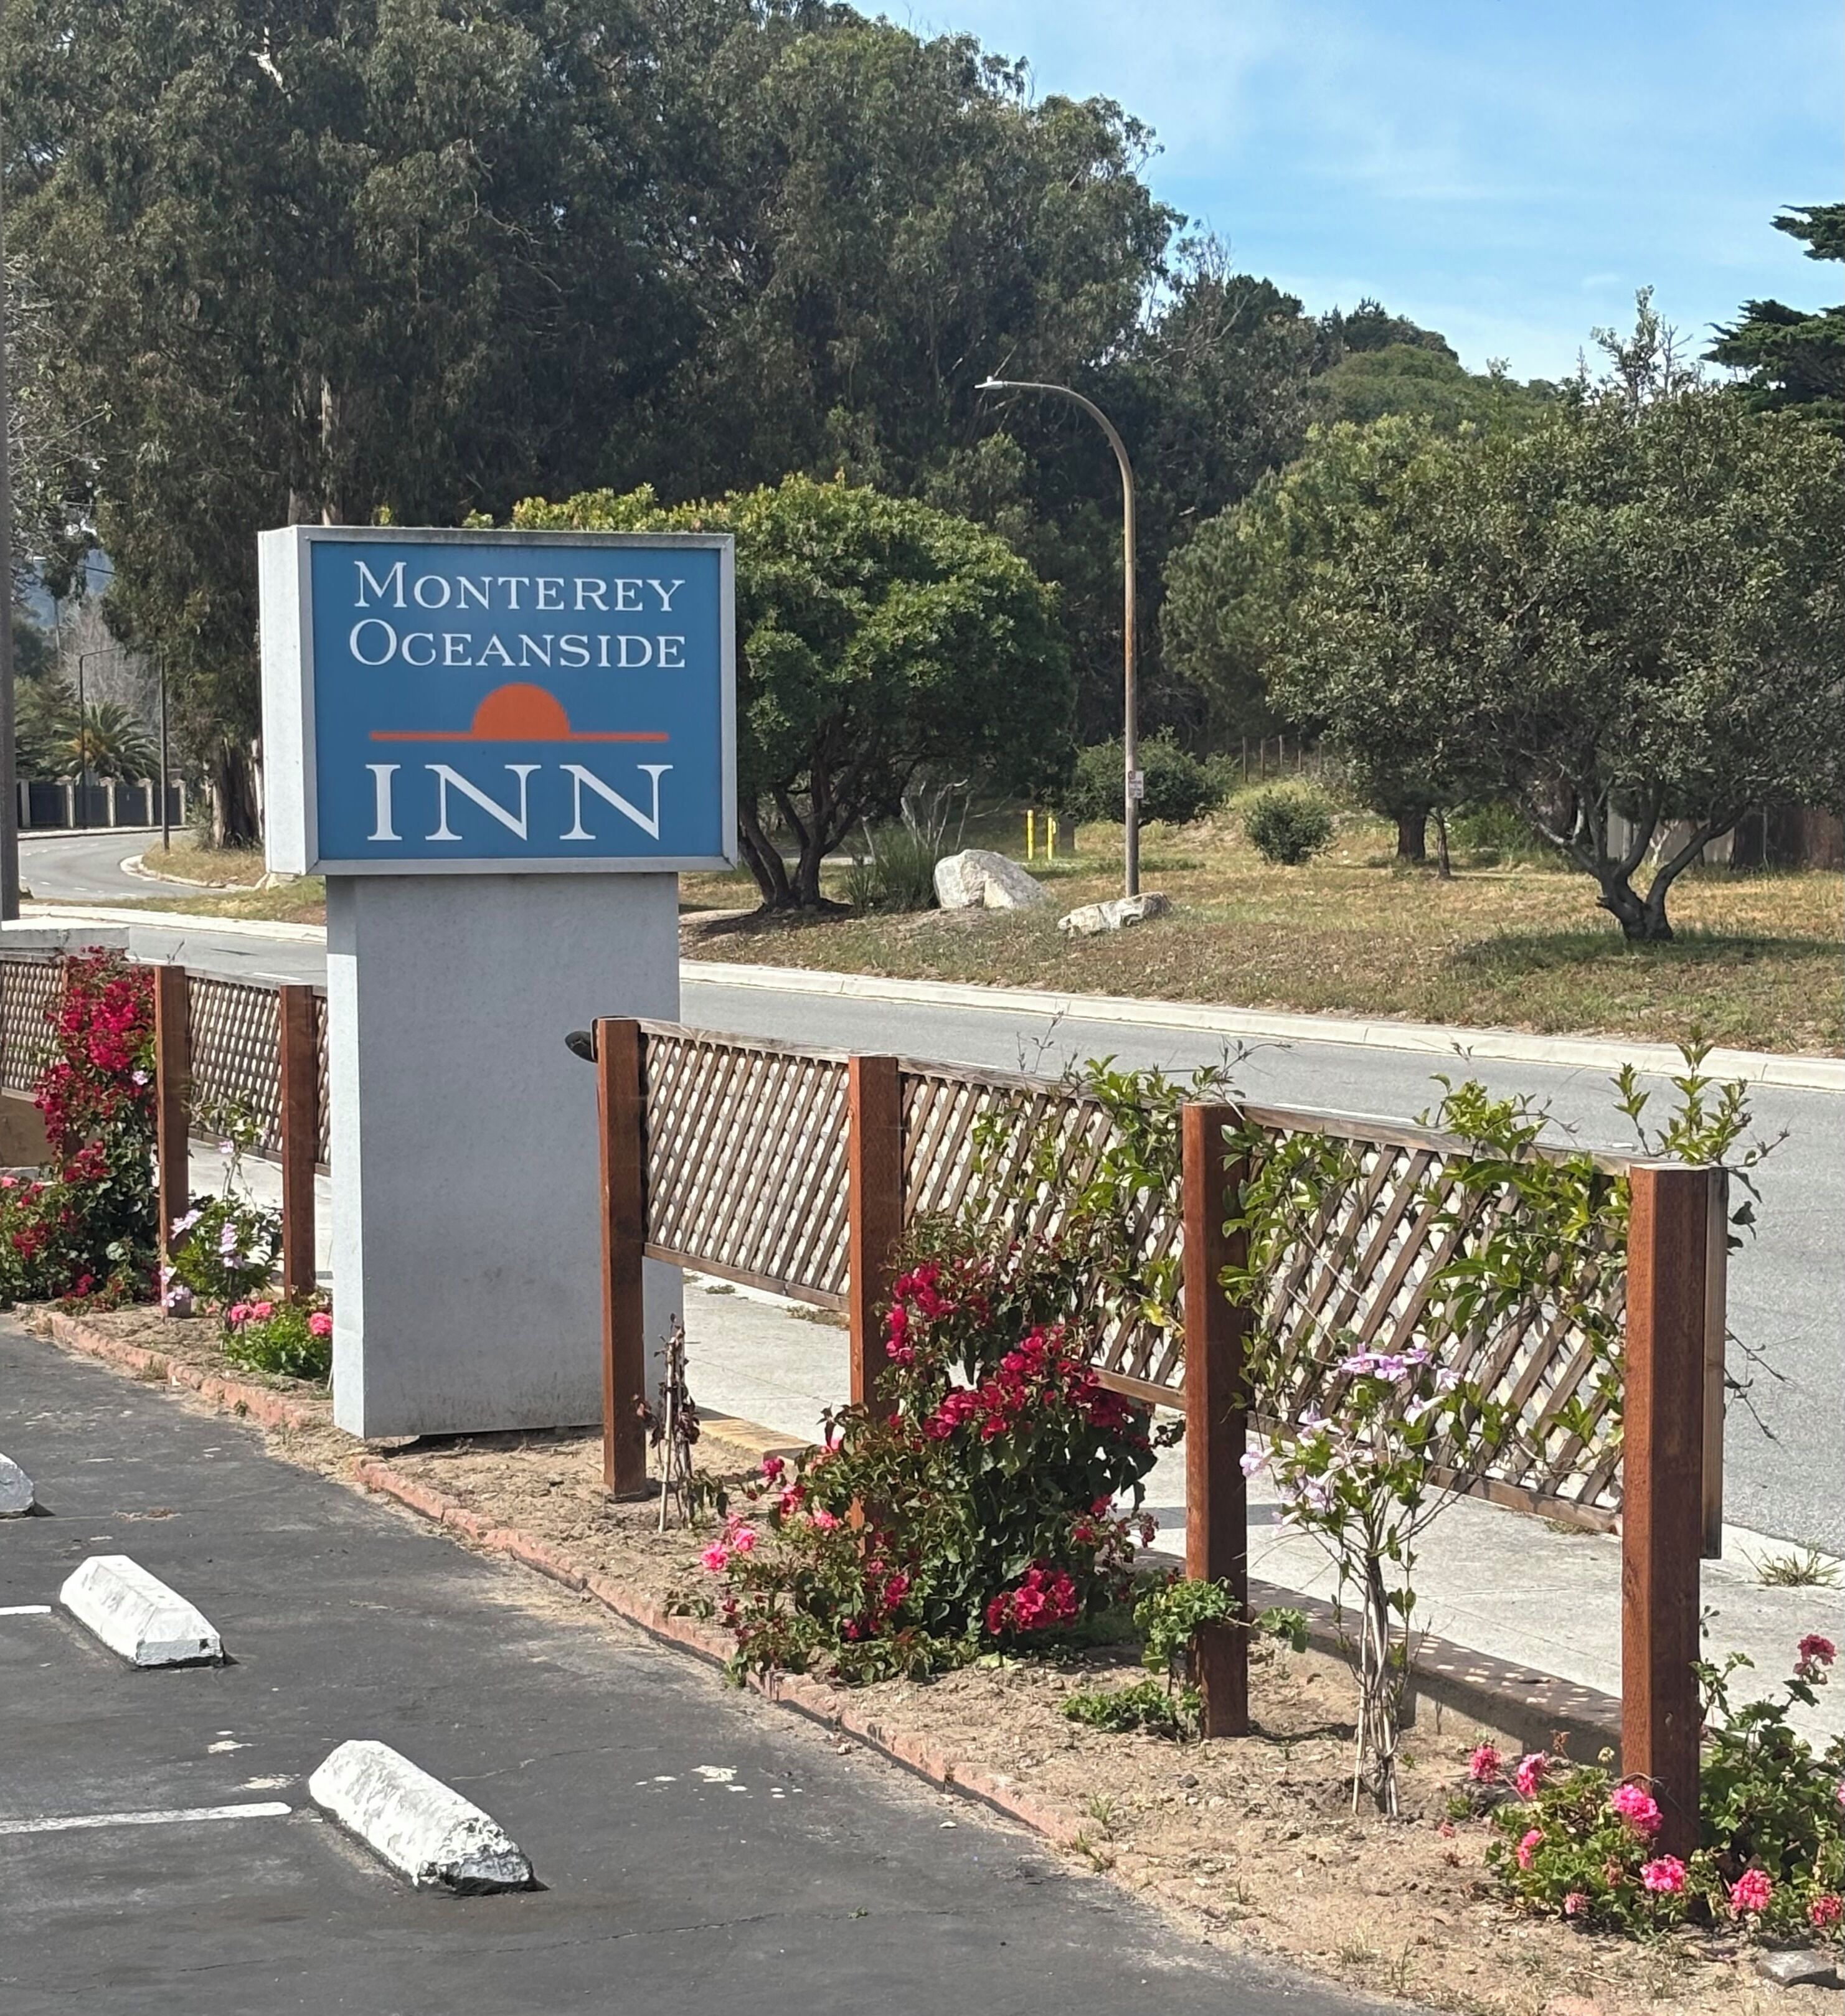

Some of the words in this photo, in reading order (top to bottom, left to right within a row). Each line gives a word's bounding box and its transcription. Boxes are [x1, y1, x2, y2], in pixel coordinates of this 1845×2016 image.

[353, 560, 686, 611] MONTEREY
[349, 618, 686, 667] OCEANSIDE
[365, 764, 673, 841] INN
